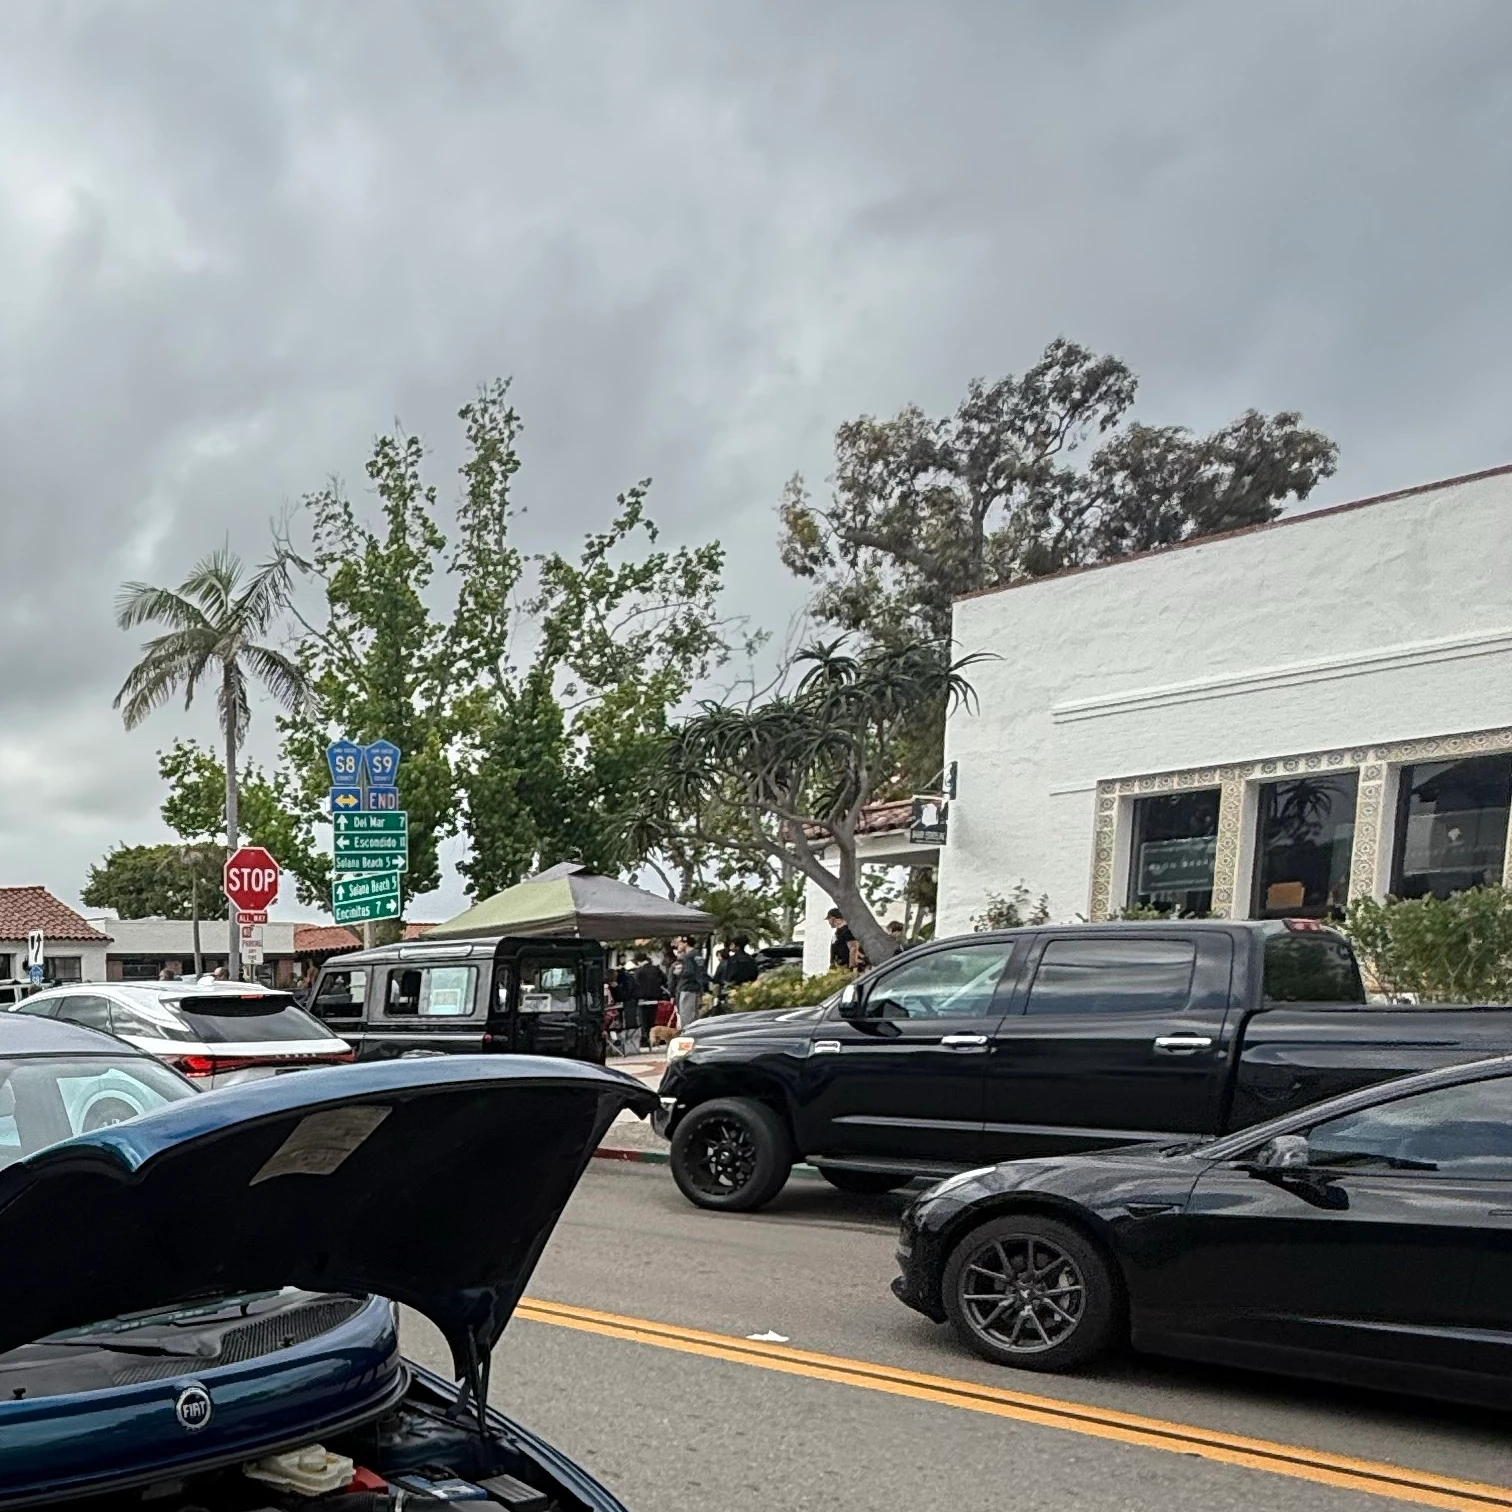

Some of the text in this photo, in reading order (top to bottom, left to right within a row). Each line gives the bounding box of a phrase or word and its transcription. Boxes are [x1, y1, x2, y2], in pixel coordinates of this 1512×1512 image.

[336, 755, 355, 773] S8
[372, 756, 392, 773] S9
[369, 792, 395, 809] END
[353, 815, 405, 828] Del Mar 7
[354, 836, 397, 848] Escondido
[336, 856, 391, 869] Solana Beach 5
[228, 867, 276, 892] STOP
[349, 875, 397, 897] Solana Beach 5
[239, 914, 266, 922] ALL WAY
[336, 901, 381, 920] Encinitas 7
[182, 1400, 206, 1419] FIAT
